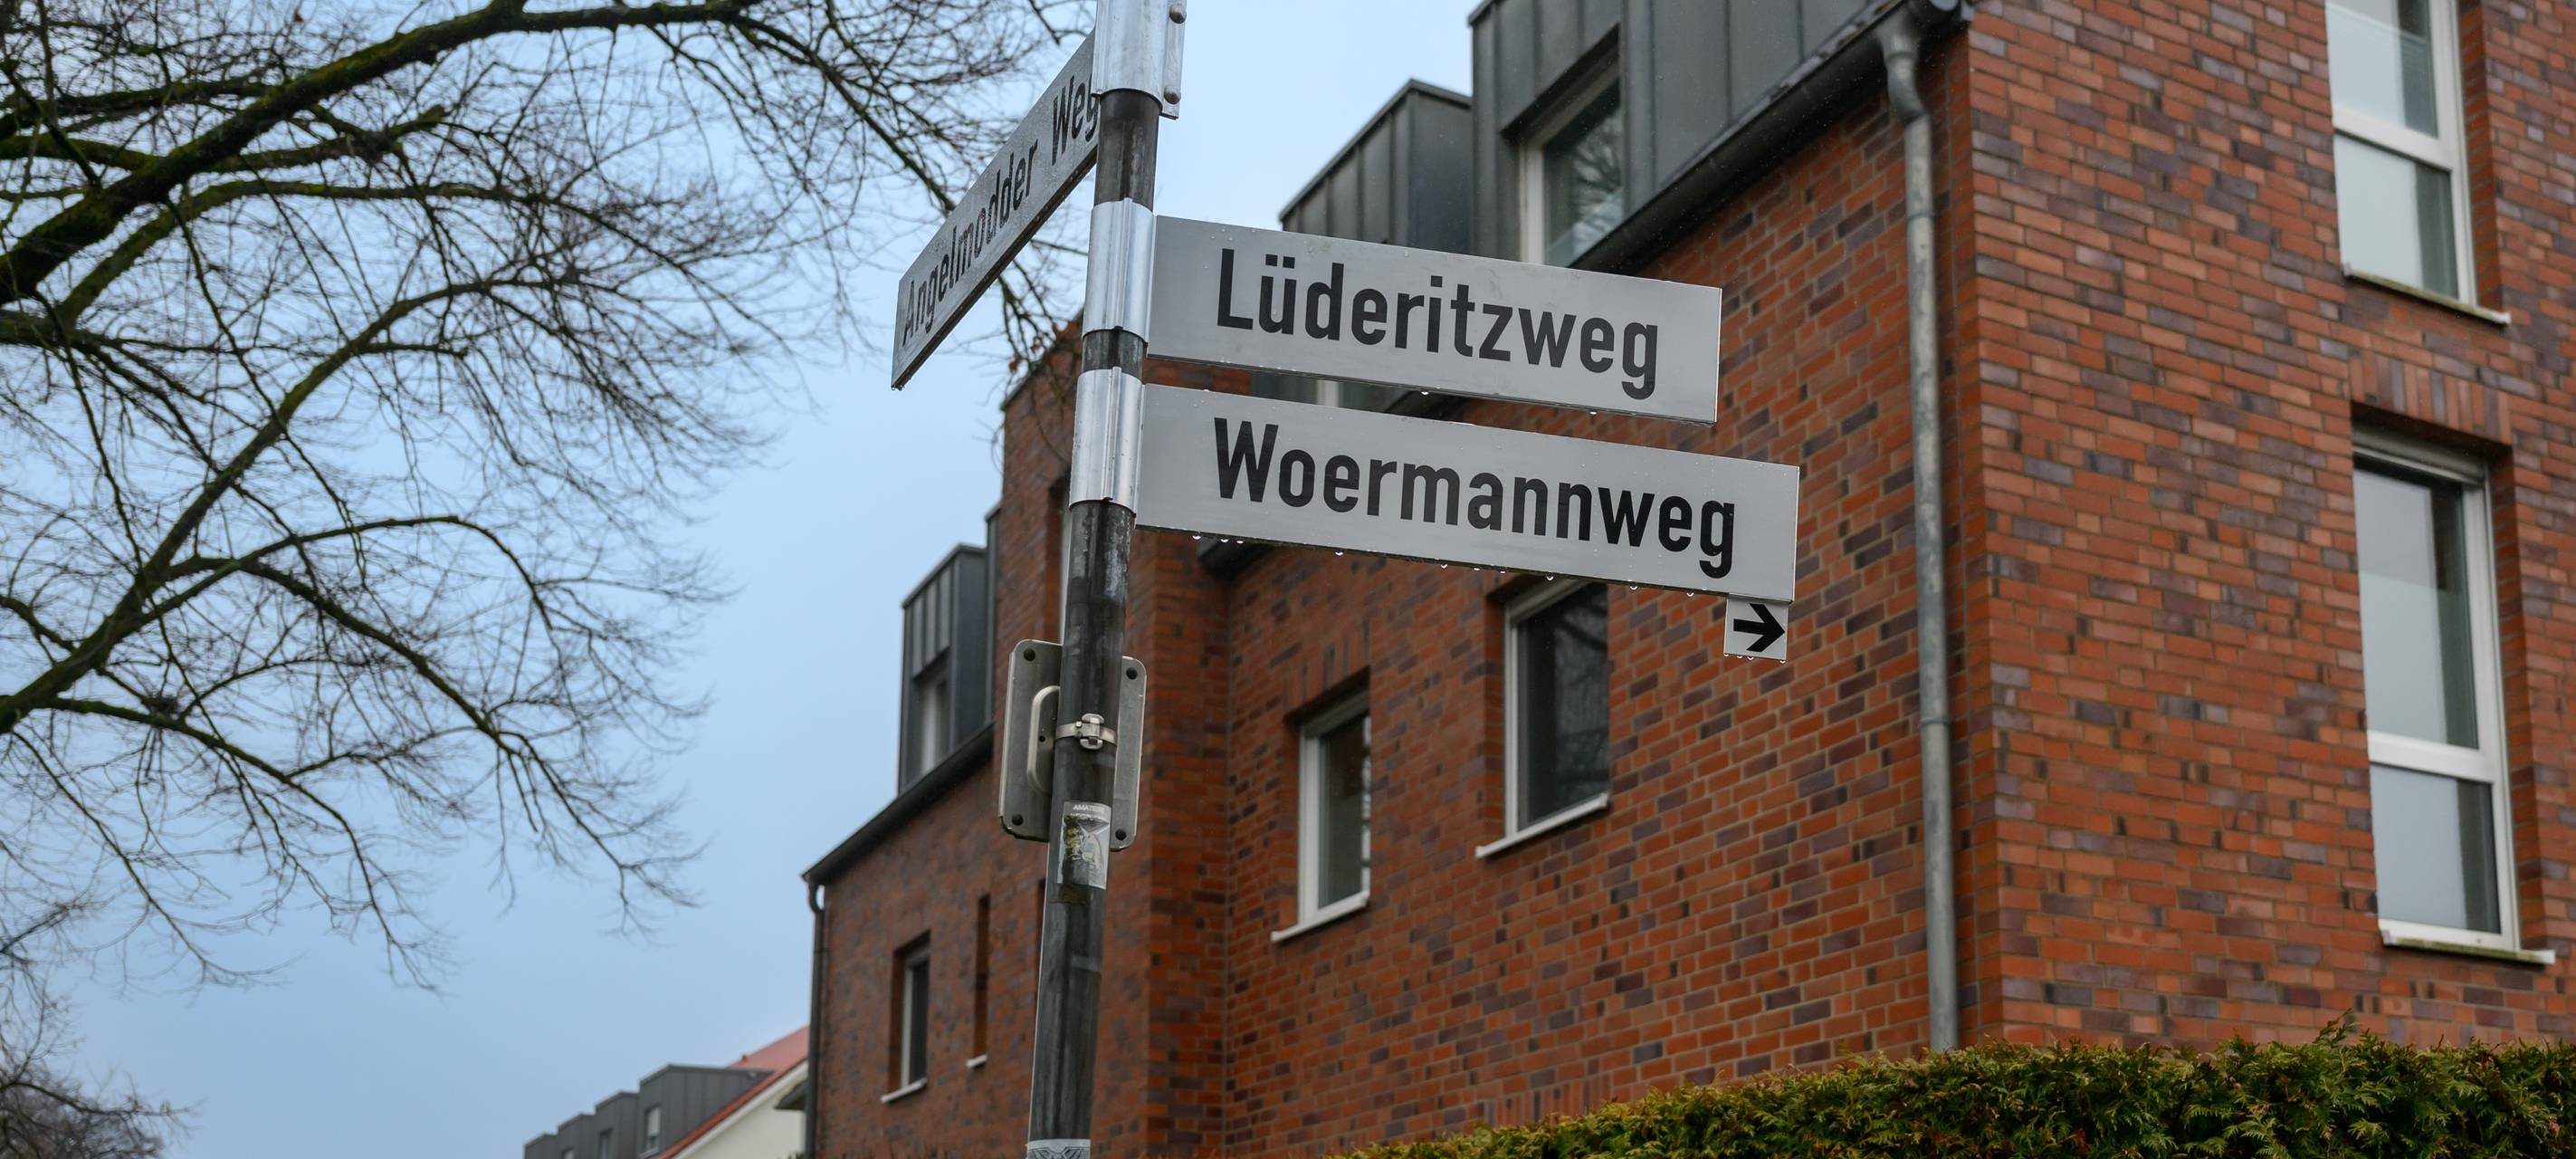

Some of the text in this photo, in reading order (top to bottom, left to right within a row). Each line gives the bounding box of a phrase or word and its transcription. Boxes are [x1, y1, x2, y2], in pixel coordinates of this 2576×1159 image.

[902, 73, 1099, 347] Angelmodder Weg
[1217, 248, 1658, 400] Lüderitzweg
[1214, 417, 1735, 580] Woermannweg
